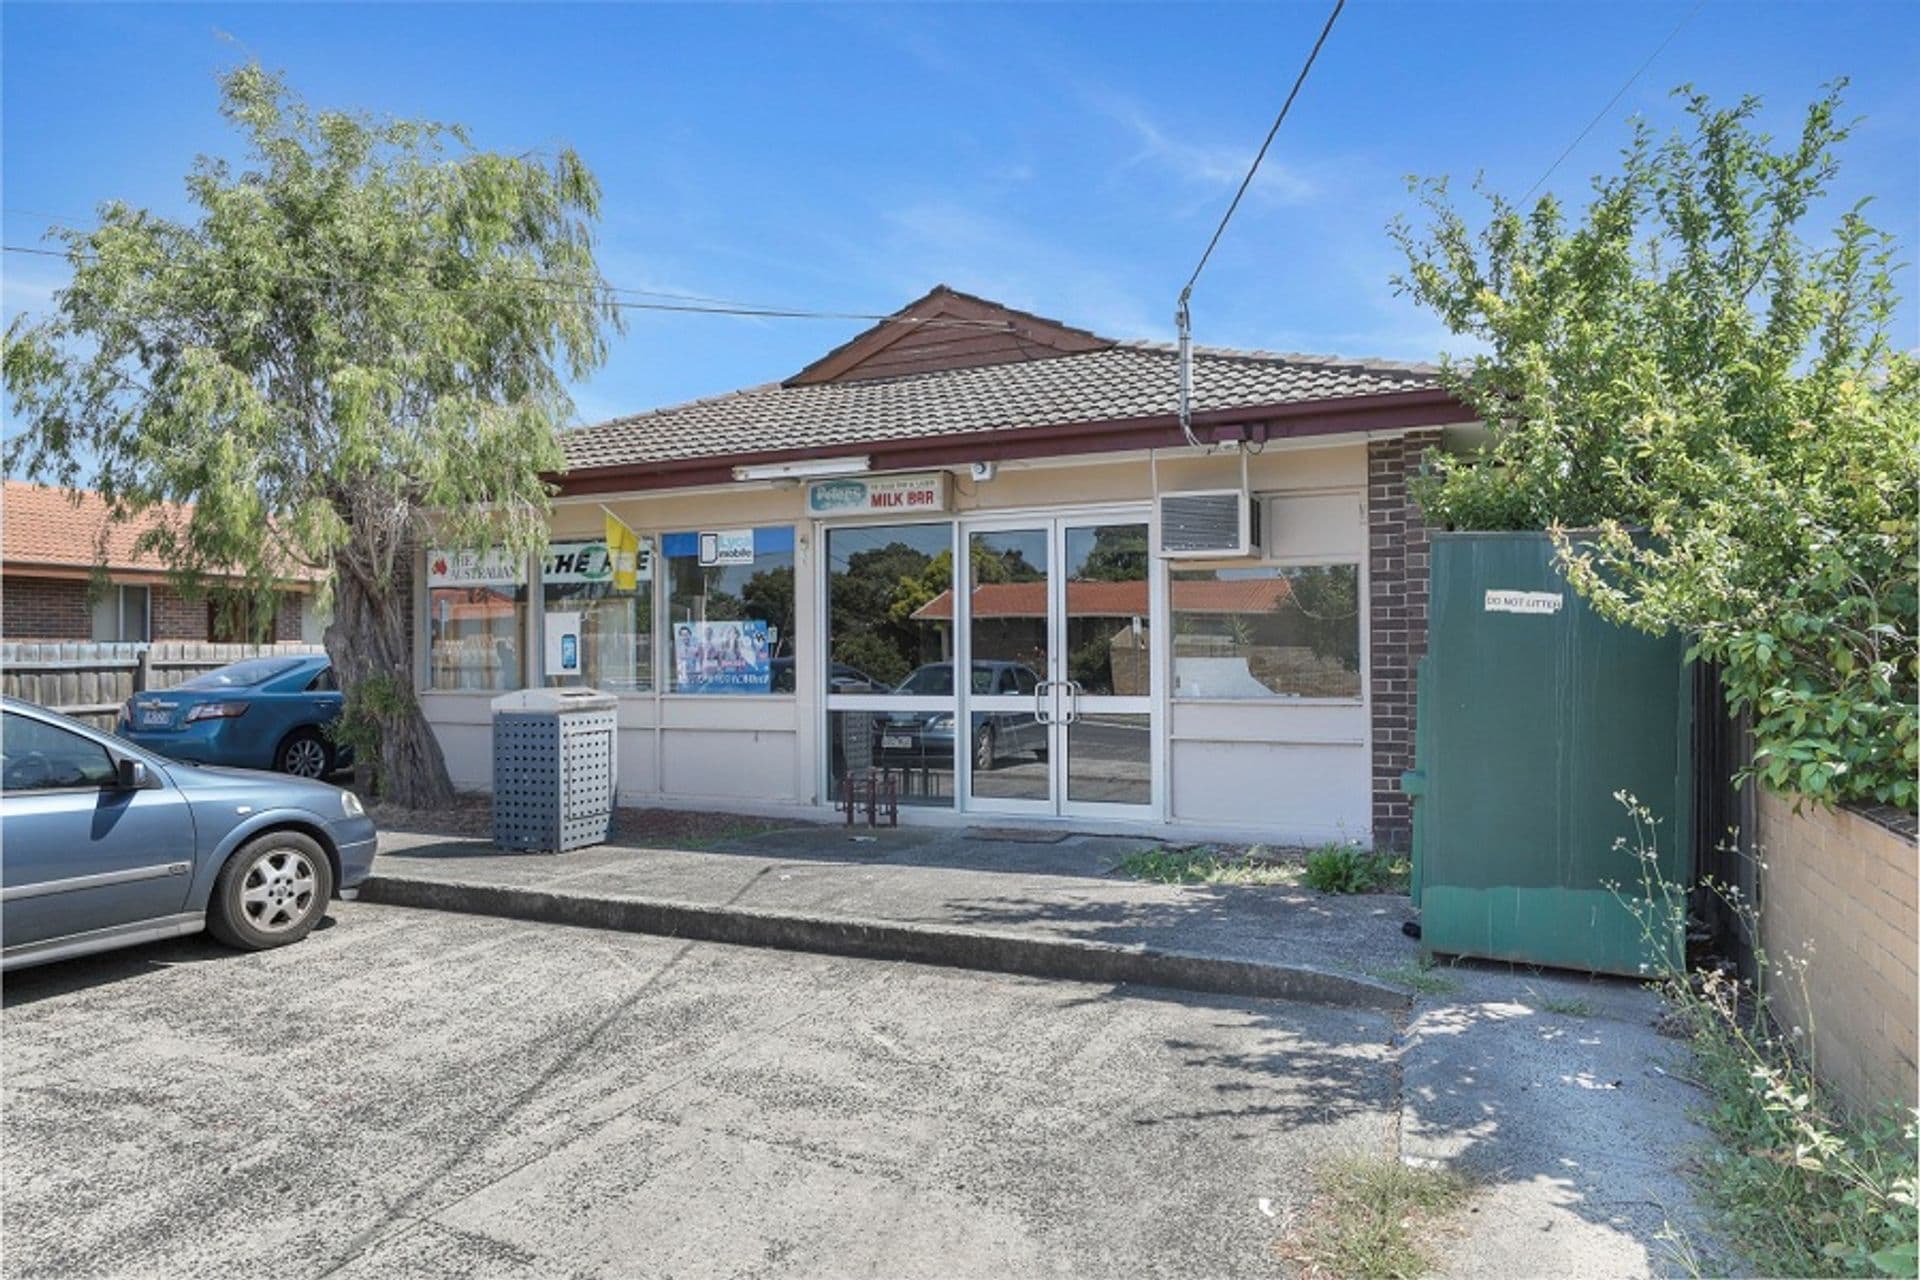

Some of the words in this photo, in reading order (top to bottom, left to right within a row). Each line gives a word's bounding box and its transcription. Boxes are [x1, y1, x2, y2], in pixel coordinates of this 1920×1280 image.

[871, 492, 904, 508] MILK
[907, 490, 934, 506] BAR
[719, 548, 753, 558] mobile
[600, 550, 650, 573] AE
[1487, 597, 1501, 605] DO
[1504, 598, 1523, 607] NOT
[1526, 599, 1561, 609] LITTER
